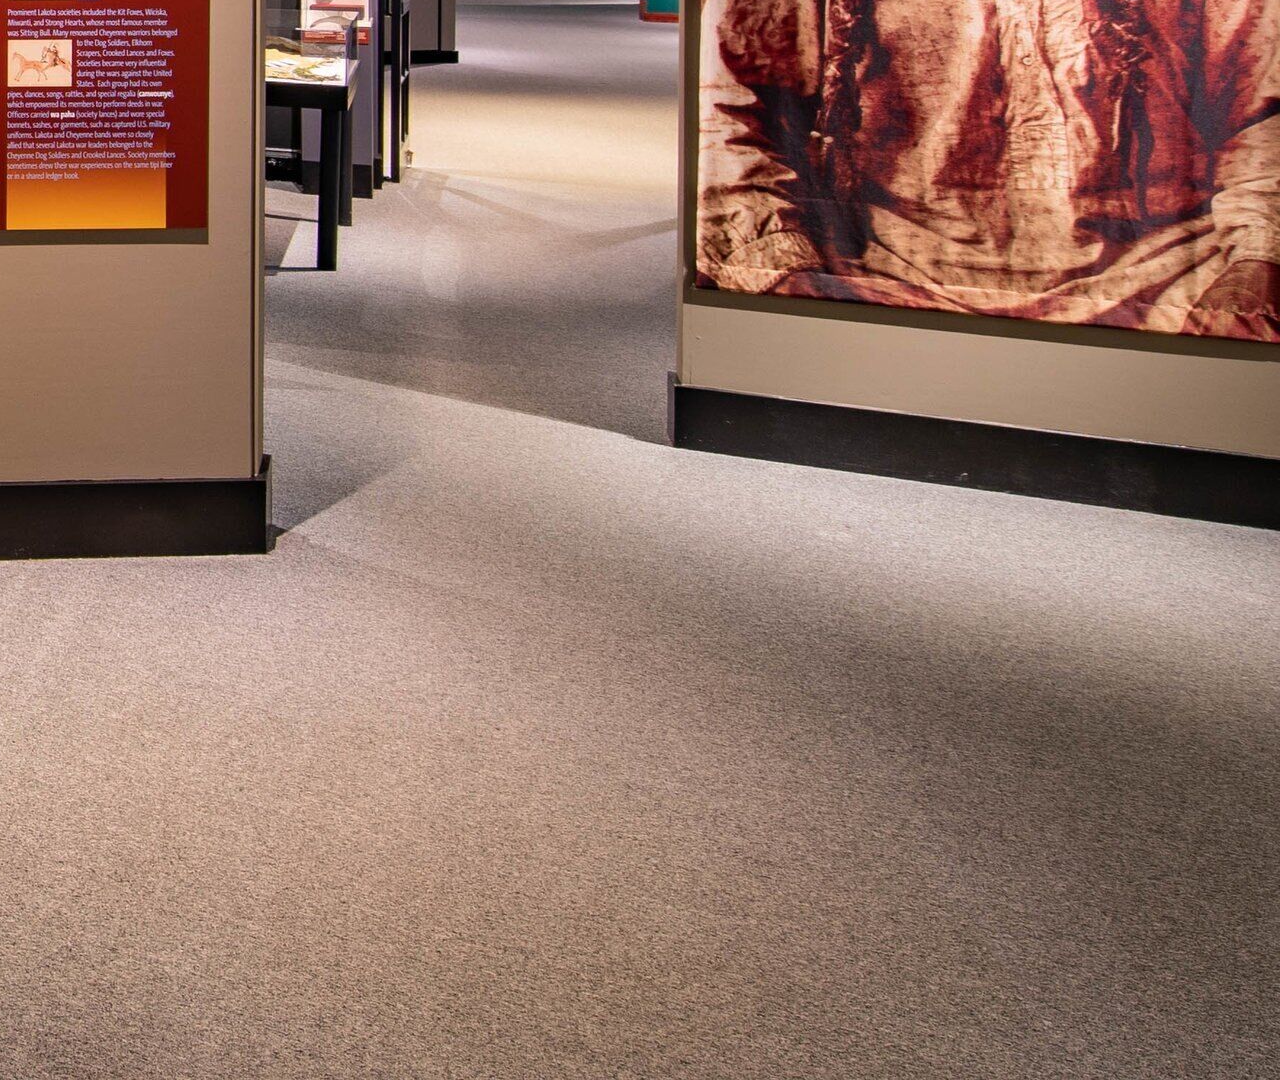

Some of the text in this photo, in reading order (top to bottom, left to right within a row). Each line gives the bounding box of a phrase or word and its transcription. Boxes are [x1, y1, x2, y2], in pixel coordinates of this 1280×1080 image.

[7, 7, 37, 16] Prominent
[37, 7, 56, 16] Lakota
[57, 7, 81, 16] societies
[82, 7, 106, 16] included
